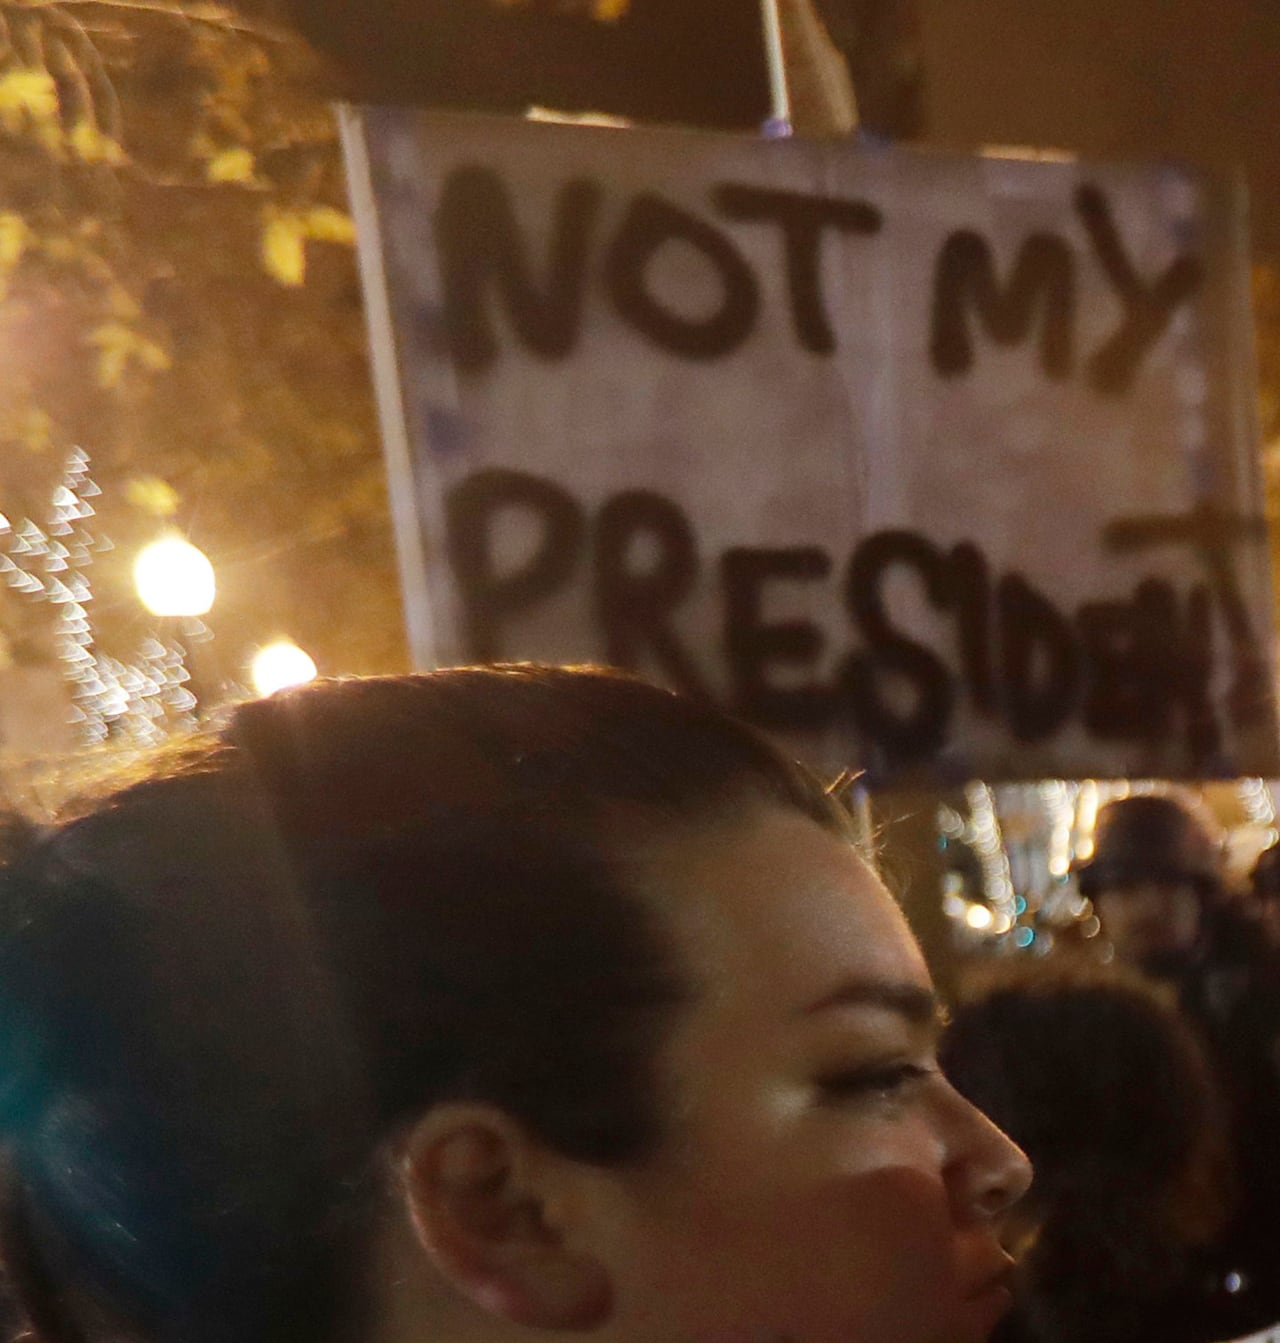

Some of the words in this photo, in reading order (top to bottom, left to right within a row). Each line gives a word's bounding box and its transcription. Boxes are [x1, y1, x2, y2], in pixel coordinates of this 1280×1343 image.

[435, 164, 883, 378] NOT
[930, 180, 1206, 395] MY
[446, 467, 1268, 764] PRESIDENT
